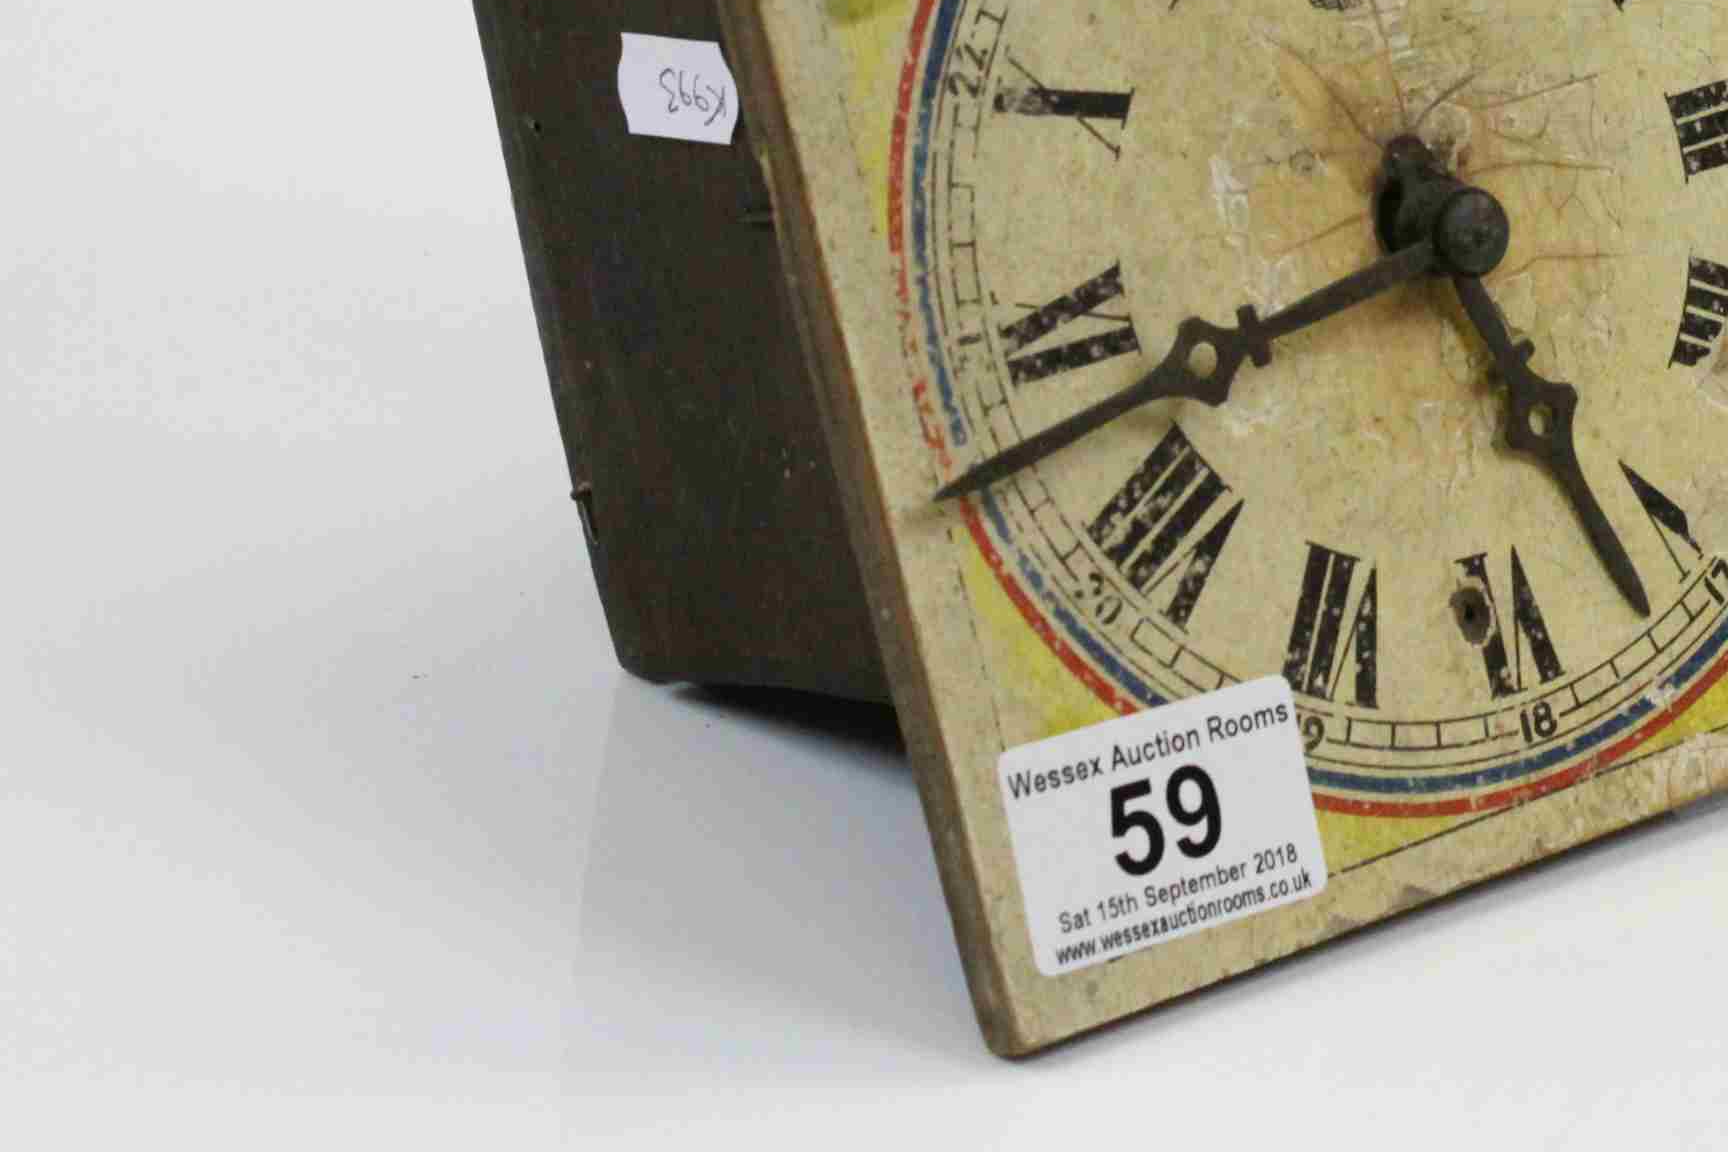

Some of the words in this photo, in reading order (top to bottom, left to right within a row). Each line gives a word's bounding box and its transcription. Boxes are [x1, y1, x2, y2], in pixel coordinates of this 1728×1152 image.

[991, 45, 1136, 162] X
[989, 258, 1142, 379] IX
[1082, 416, 1246, 636] VIII
[1618, 458, 1705, 585] V
[1282, 538, 1380, 711] VII
[1453, 543, 1567, 702] VI
[1007, 757, 1103, 800] Wessex
[1110, 728, 1201, 772] Auction
[1205, 702, 1289, 744] Rooms
[1296, 713, 1325, 753] 9
[1519, 700, 1558, 744] 18
[1109, 764, 1223, 877] 59
[1055, 868, 1313, 966] www.wessexauctionrooms.co.uk
[1058, 910, 1092, 935] Sat
[1097, 892, 1140, 922] 15th
[1143, 859, 1248, 908] September
[1253, 842, 1299, 875] 2018
